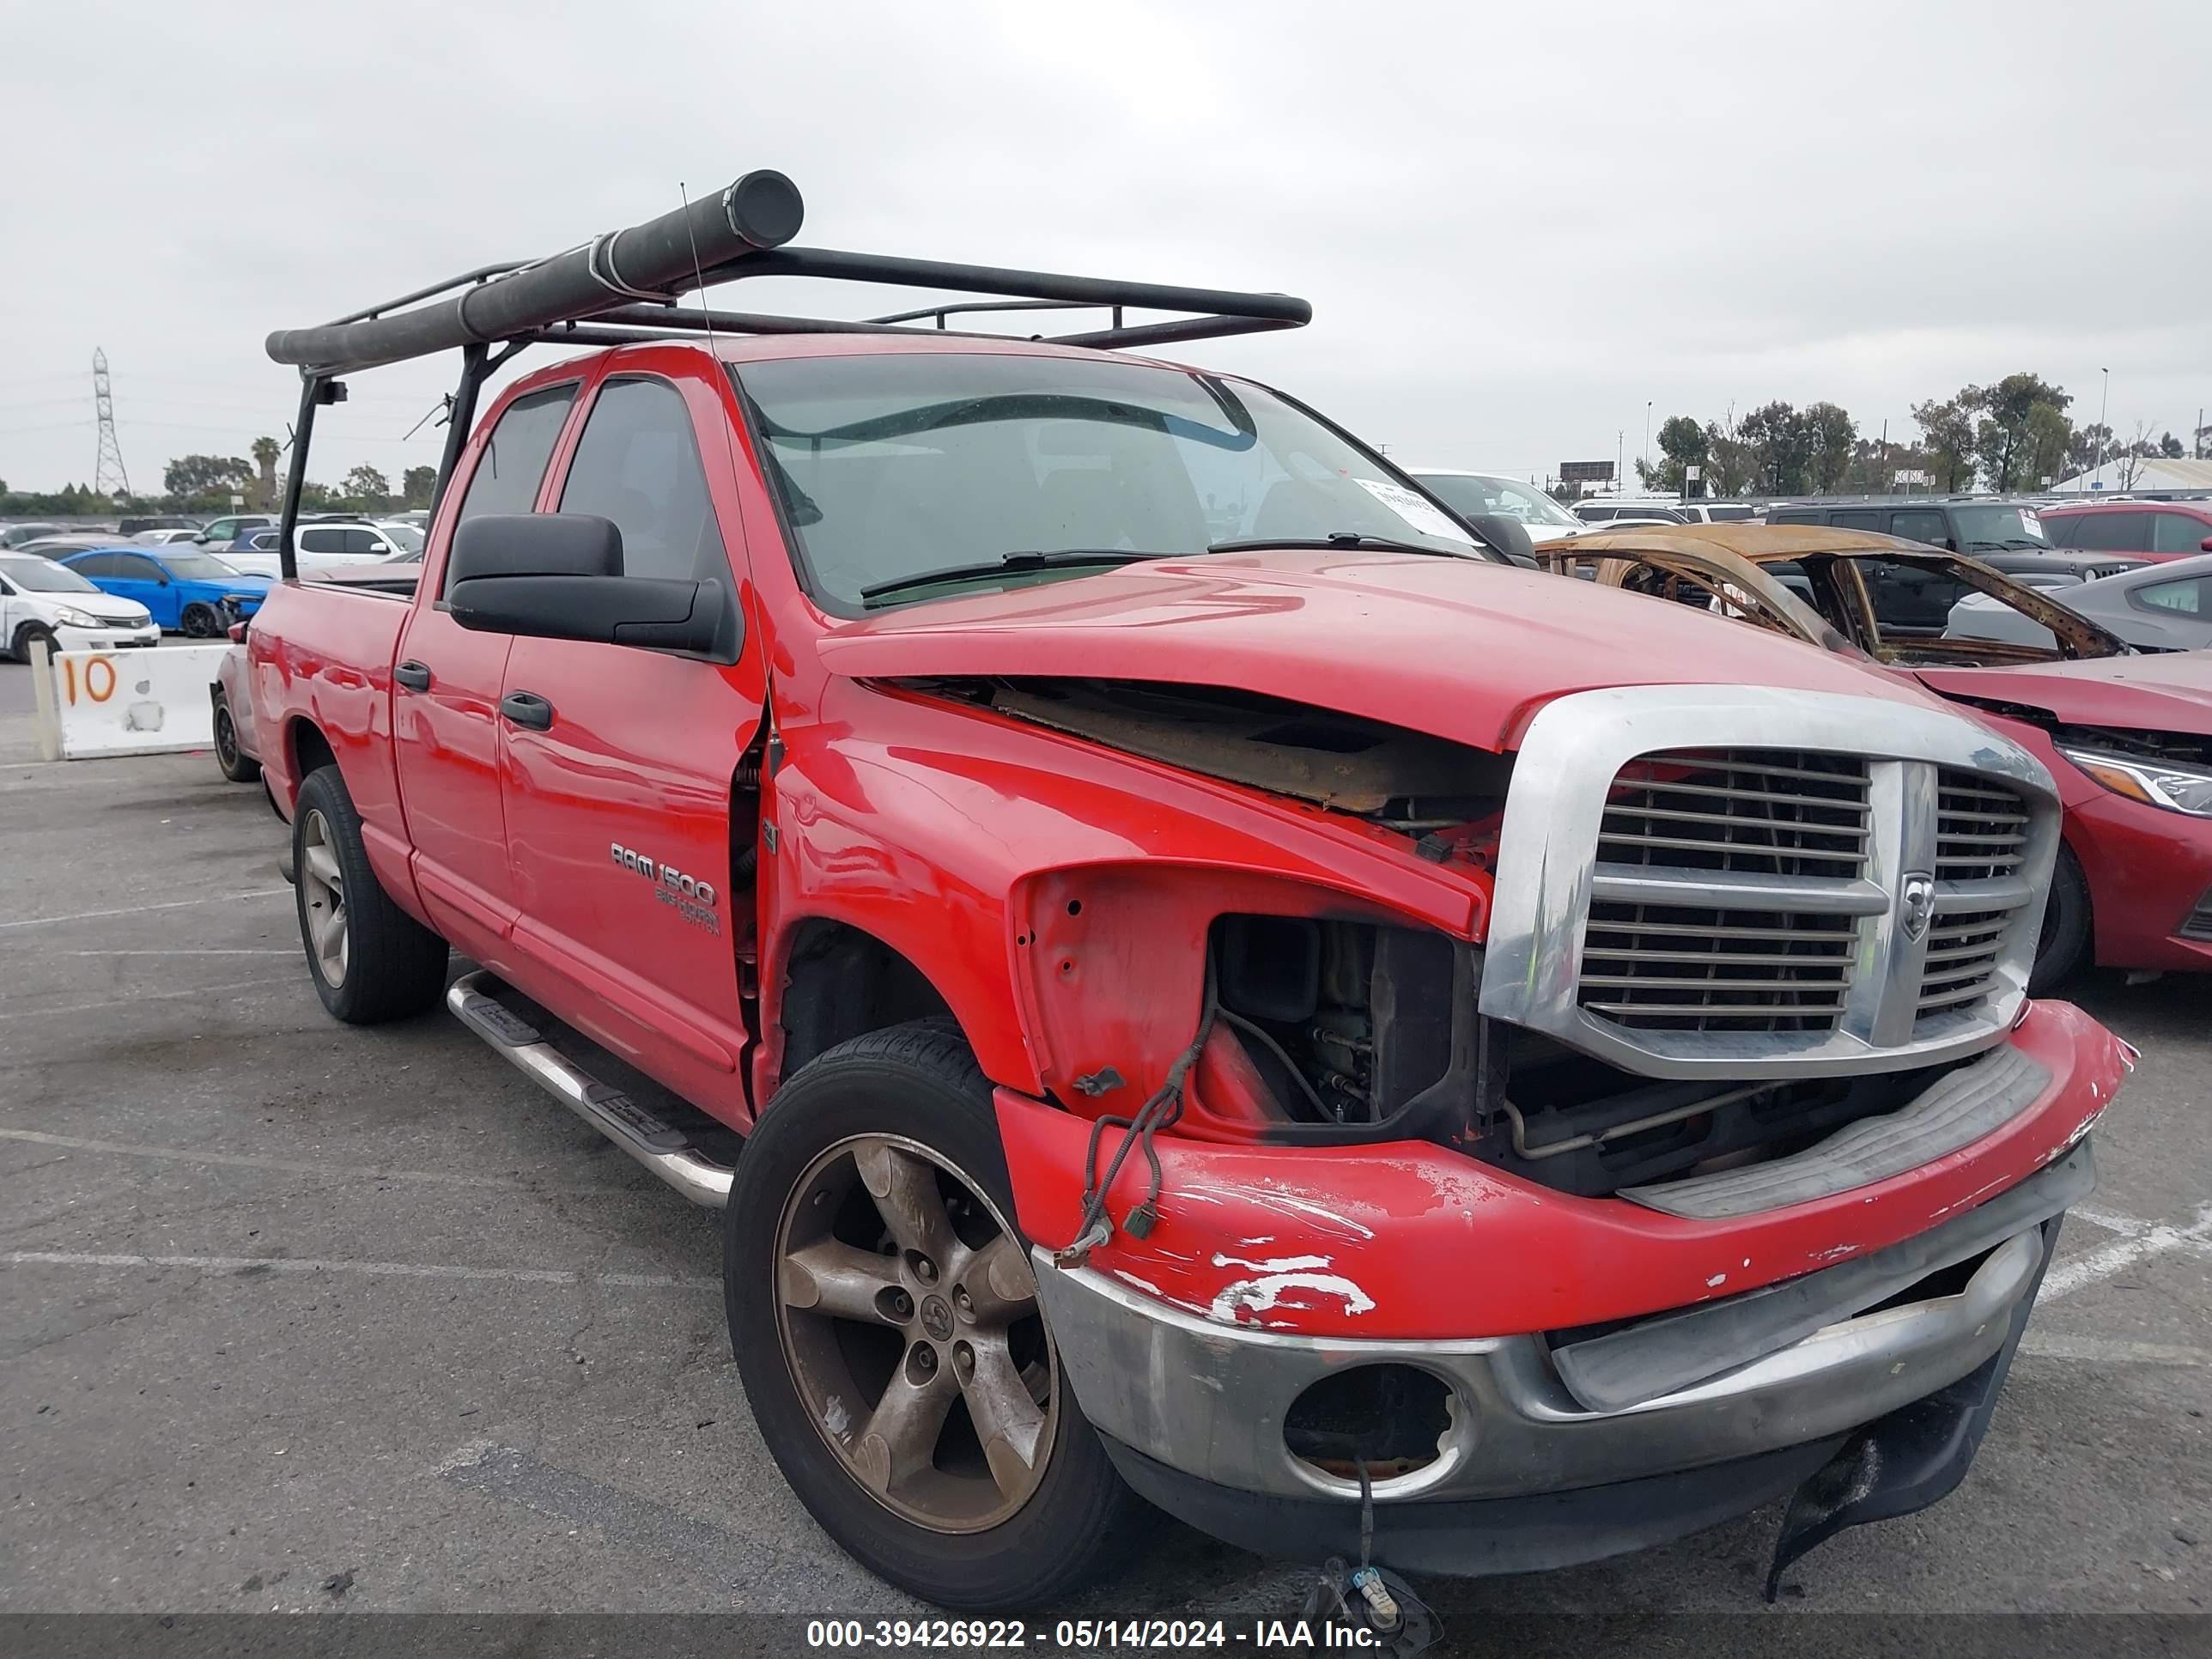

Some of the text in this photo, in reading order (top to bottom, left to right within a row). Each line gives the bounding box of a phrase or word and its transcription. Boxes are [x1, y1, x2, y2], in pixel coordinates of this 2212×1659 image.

[1896, 471, 1907, 482] SC
[1911, 471, 1923, 482] SD
[65, 656, 116, 706] 10
[611, 842, 716, 907] RAM 1500
